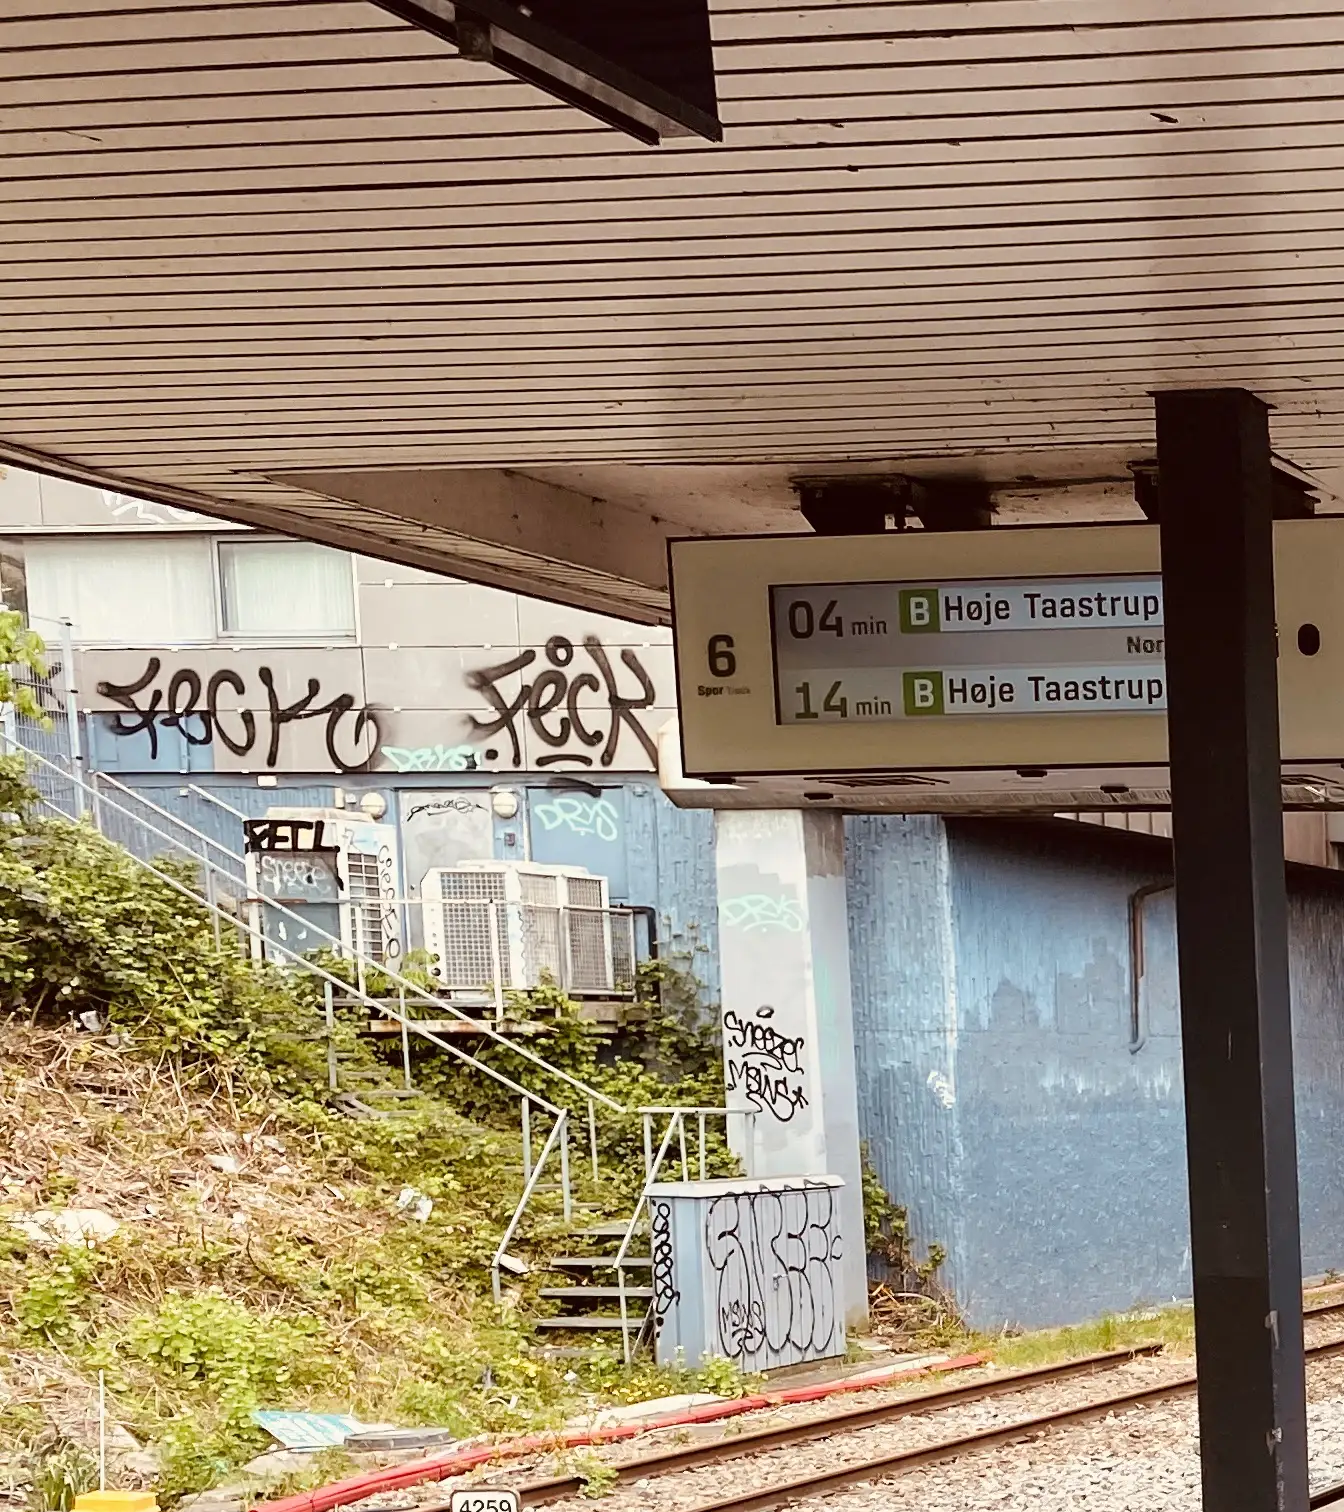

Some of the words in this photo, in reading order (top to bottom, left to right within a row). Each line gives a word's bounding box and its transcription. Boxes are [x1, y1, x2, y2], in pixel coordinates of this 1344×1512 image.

[788, 599, 844, 639] 04
[851, 615, 888, 636] min
[909, 596, 930, 626] B
[944, 592, 1011, 626] Høje
[1023, 592, 1160, 621] Taastrup
[707, 633, 737, 678] 6
[697, 684, 724, 698] Spor
[794, 680, 848, 719] 14
[855, 696, 892, 716] min
[914, 678, 935, 708] B
[948, 676, 1015, 708] Høje
[1027, 675, 1163, 704] Taastrup
